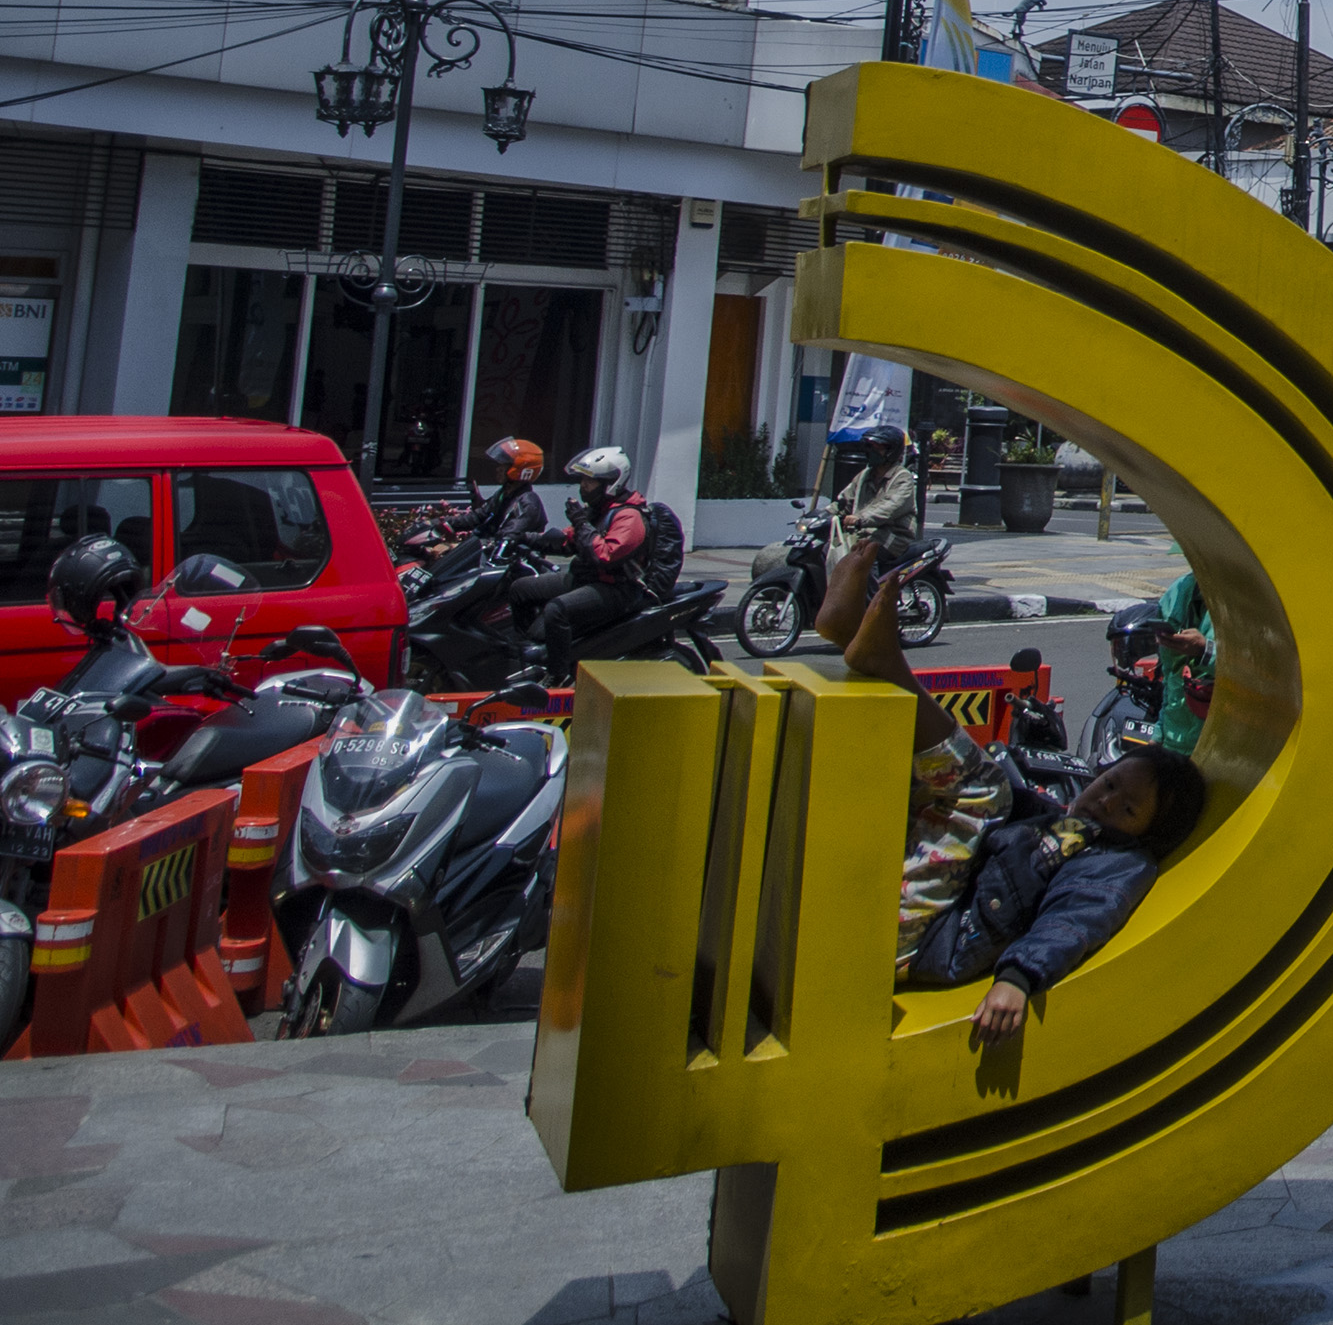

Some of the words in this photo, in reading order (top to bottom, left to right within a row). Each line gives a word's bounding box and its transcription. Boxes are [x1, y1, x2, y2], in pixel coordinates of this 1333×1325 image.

[1077, 40, 1111, 53] Menuju
[1080, 57, 1105, 71] Jalan
[1069, 73, 1112, 89] Naripan
[13, 304, 47, 319] BNI
[346, 738, 386, 753] 5298
